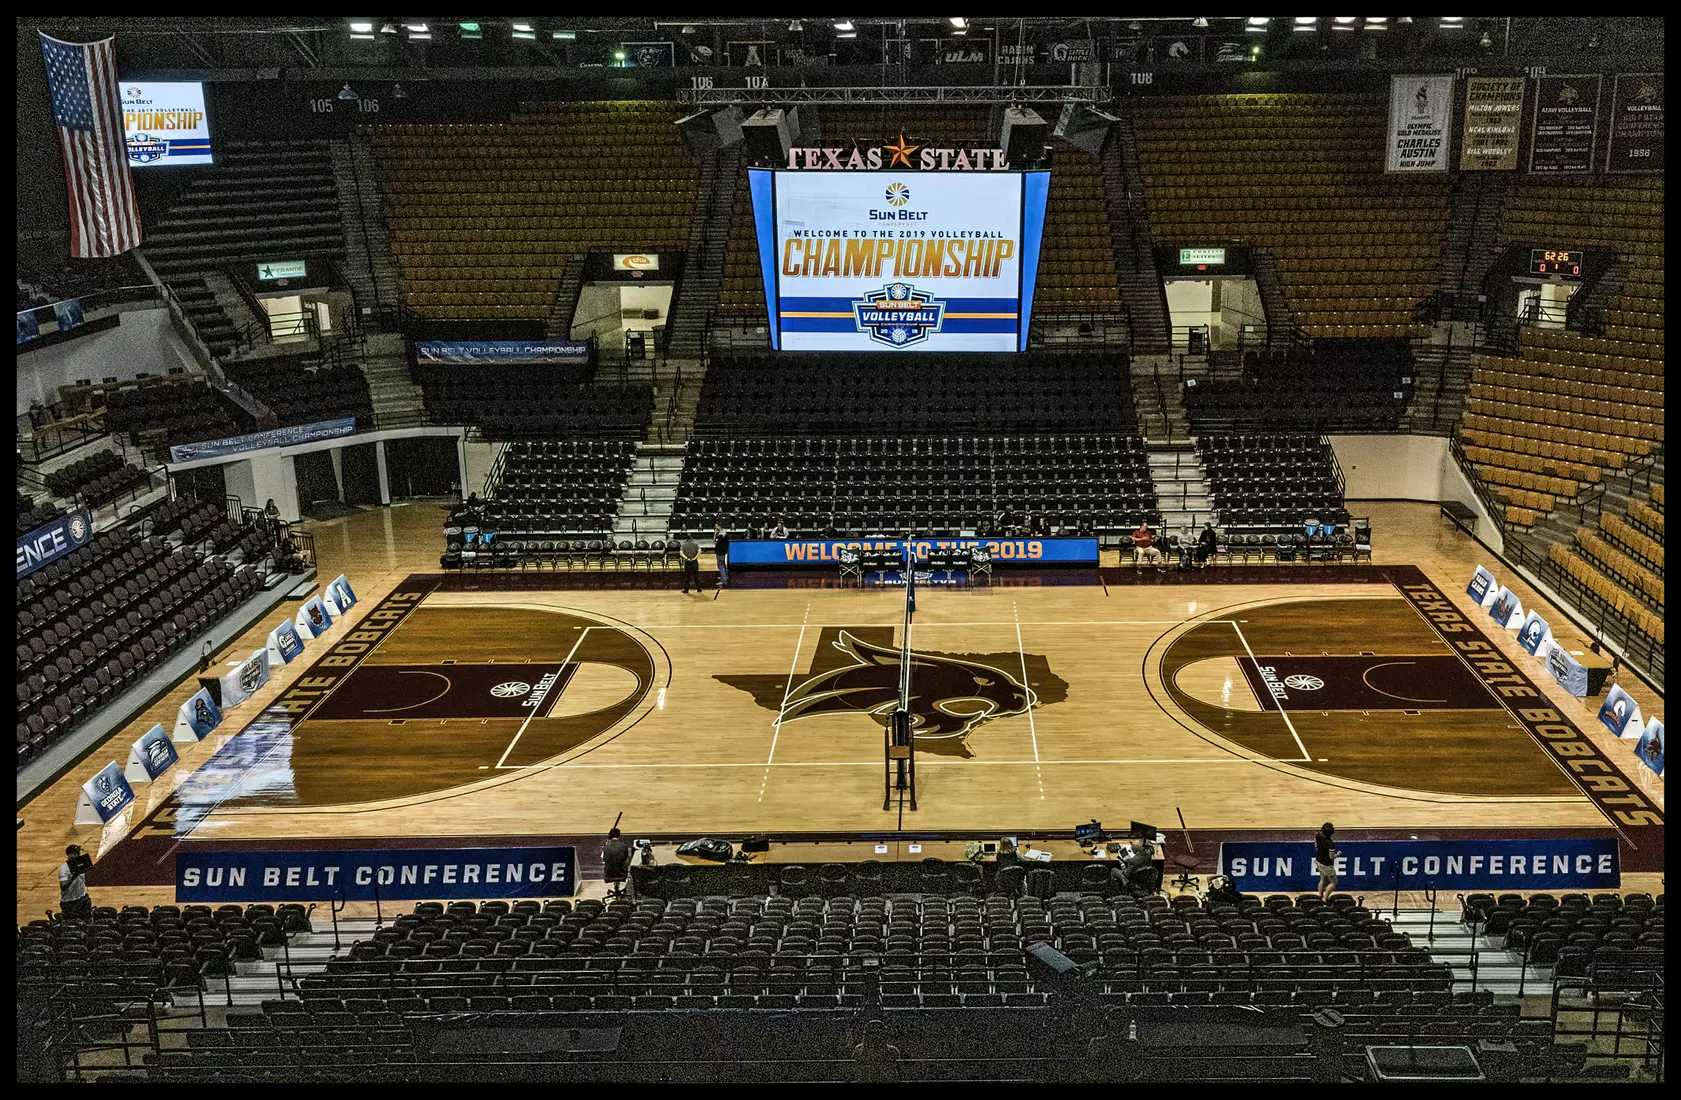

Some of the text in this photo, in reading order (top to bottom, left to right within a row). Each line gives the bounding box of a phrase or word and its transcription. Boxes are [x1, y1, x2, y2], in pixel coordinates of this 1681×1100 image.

[691, 76, 714, 89] 106
[1470, 82, 1522, 91] SOCIETY OF
[1469, 92, 1522, 101] CHAMPIONS
[310, 99, 333, 112] 105
[357, 99, 380, 112] 106
[1397, 138, 1440, 148] CHARLES
[787, 148, 1009, 170] TEXAS STATE
[1400, 148, 1436, 158] AUSTIN
[869, 210, 928, 220] SUN BELT
[782, 239, 1014, 278] CHAMPIONSHIP
[1540, 264, 1546, 272] 0
[1573, 266, 1579, 274] 0
[863, 312, 934, 321] VOLLEYBALL
[200, 426, 304, 449] SUN BELT CONFERENCE
[232, 426, 352, 452] VOLLEYBALL CHAMPIONSHIP
[986, 542, 1042, 559] 2019
[318, 592, 422, 666] BOBCATS
[522, 672, 556, 706] SUN BELT
[1260, 666, 1289, 700] SUN BELT
[1402, 584, 1664, 826] TEXAS STATE BOBCATS
[1231, 857, 1292, 876] SUN
[1402, 854, 1612, 876] CONFERENCE
[183, 862, 566, 886] SUN BELT CONFERENCE
